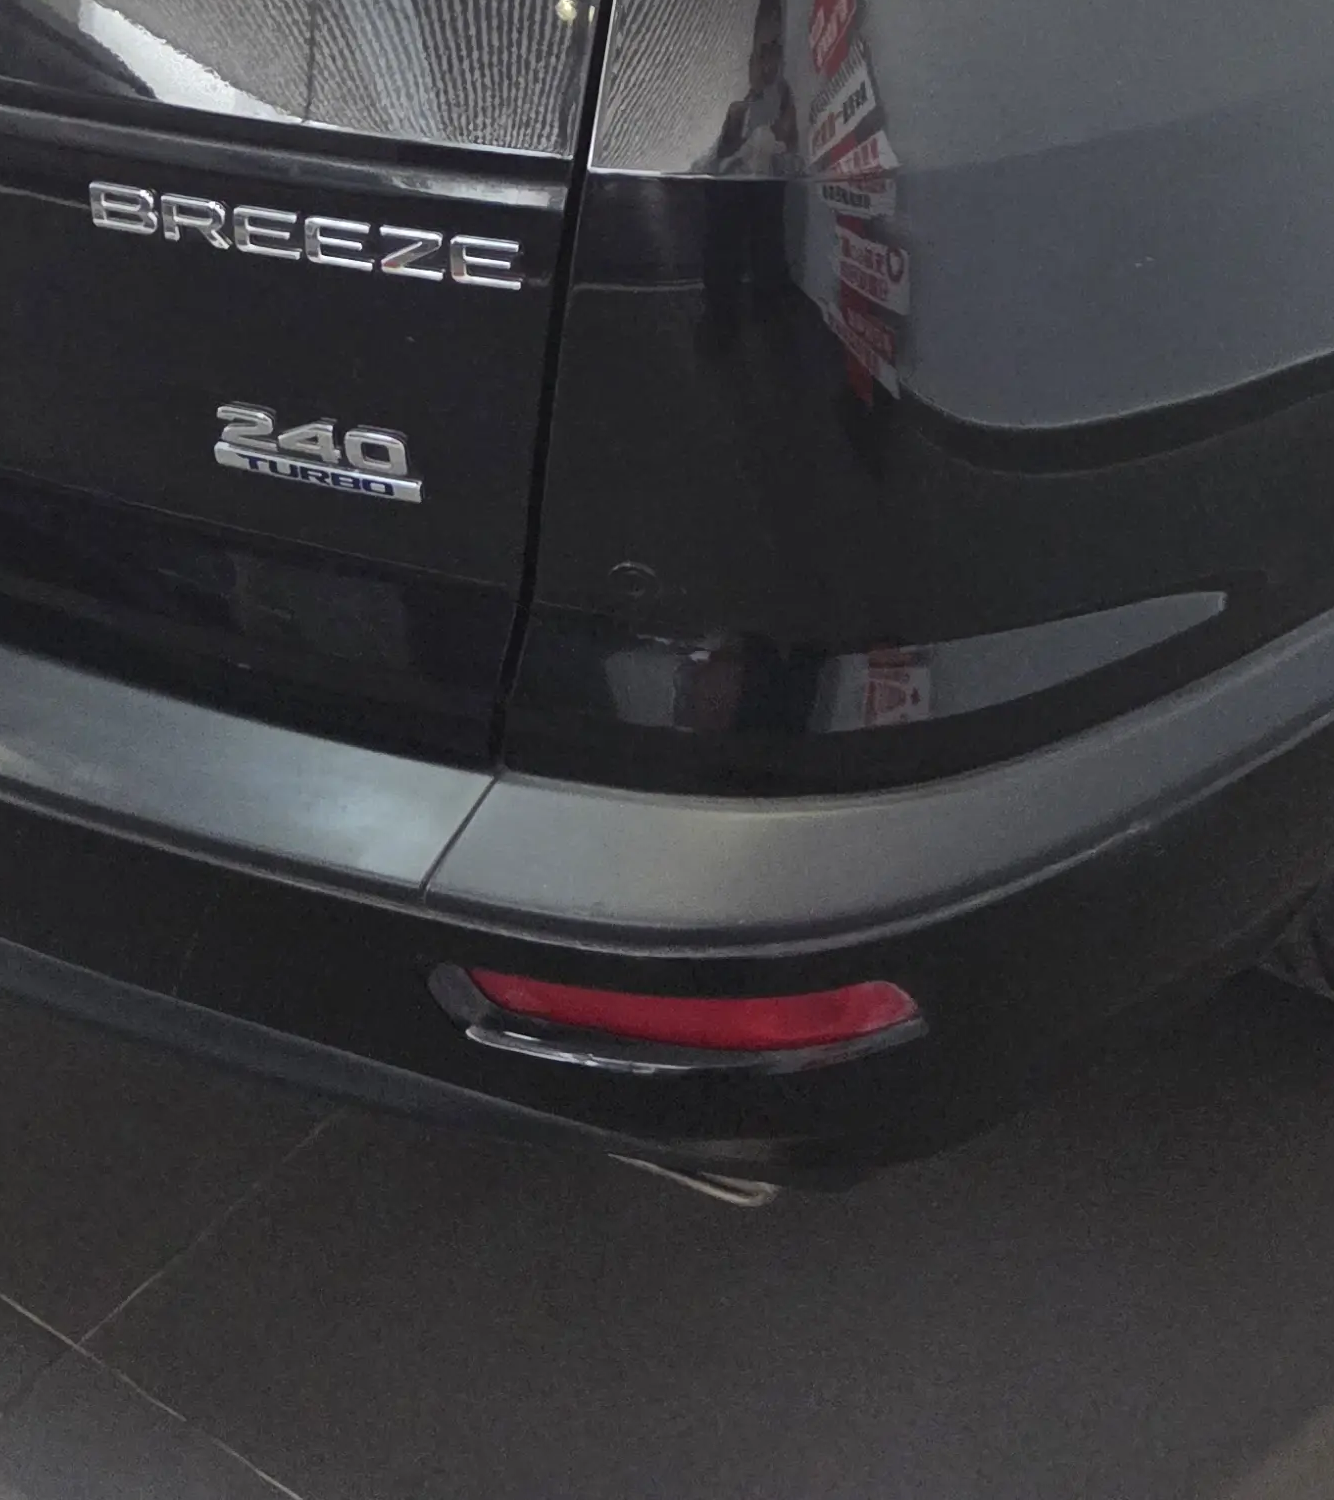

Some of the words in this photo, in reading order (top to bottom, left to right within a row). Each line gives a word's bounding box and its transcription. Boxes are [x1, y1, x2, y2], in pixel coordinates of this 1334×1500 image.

[88, 180, 524, 290] BREEZE
[216, 402, 409, 476] 240
[236, 453, 395, 496] TURBO
